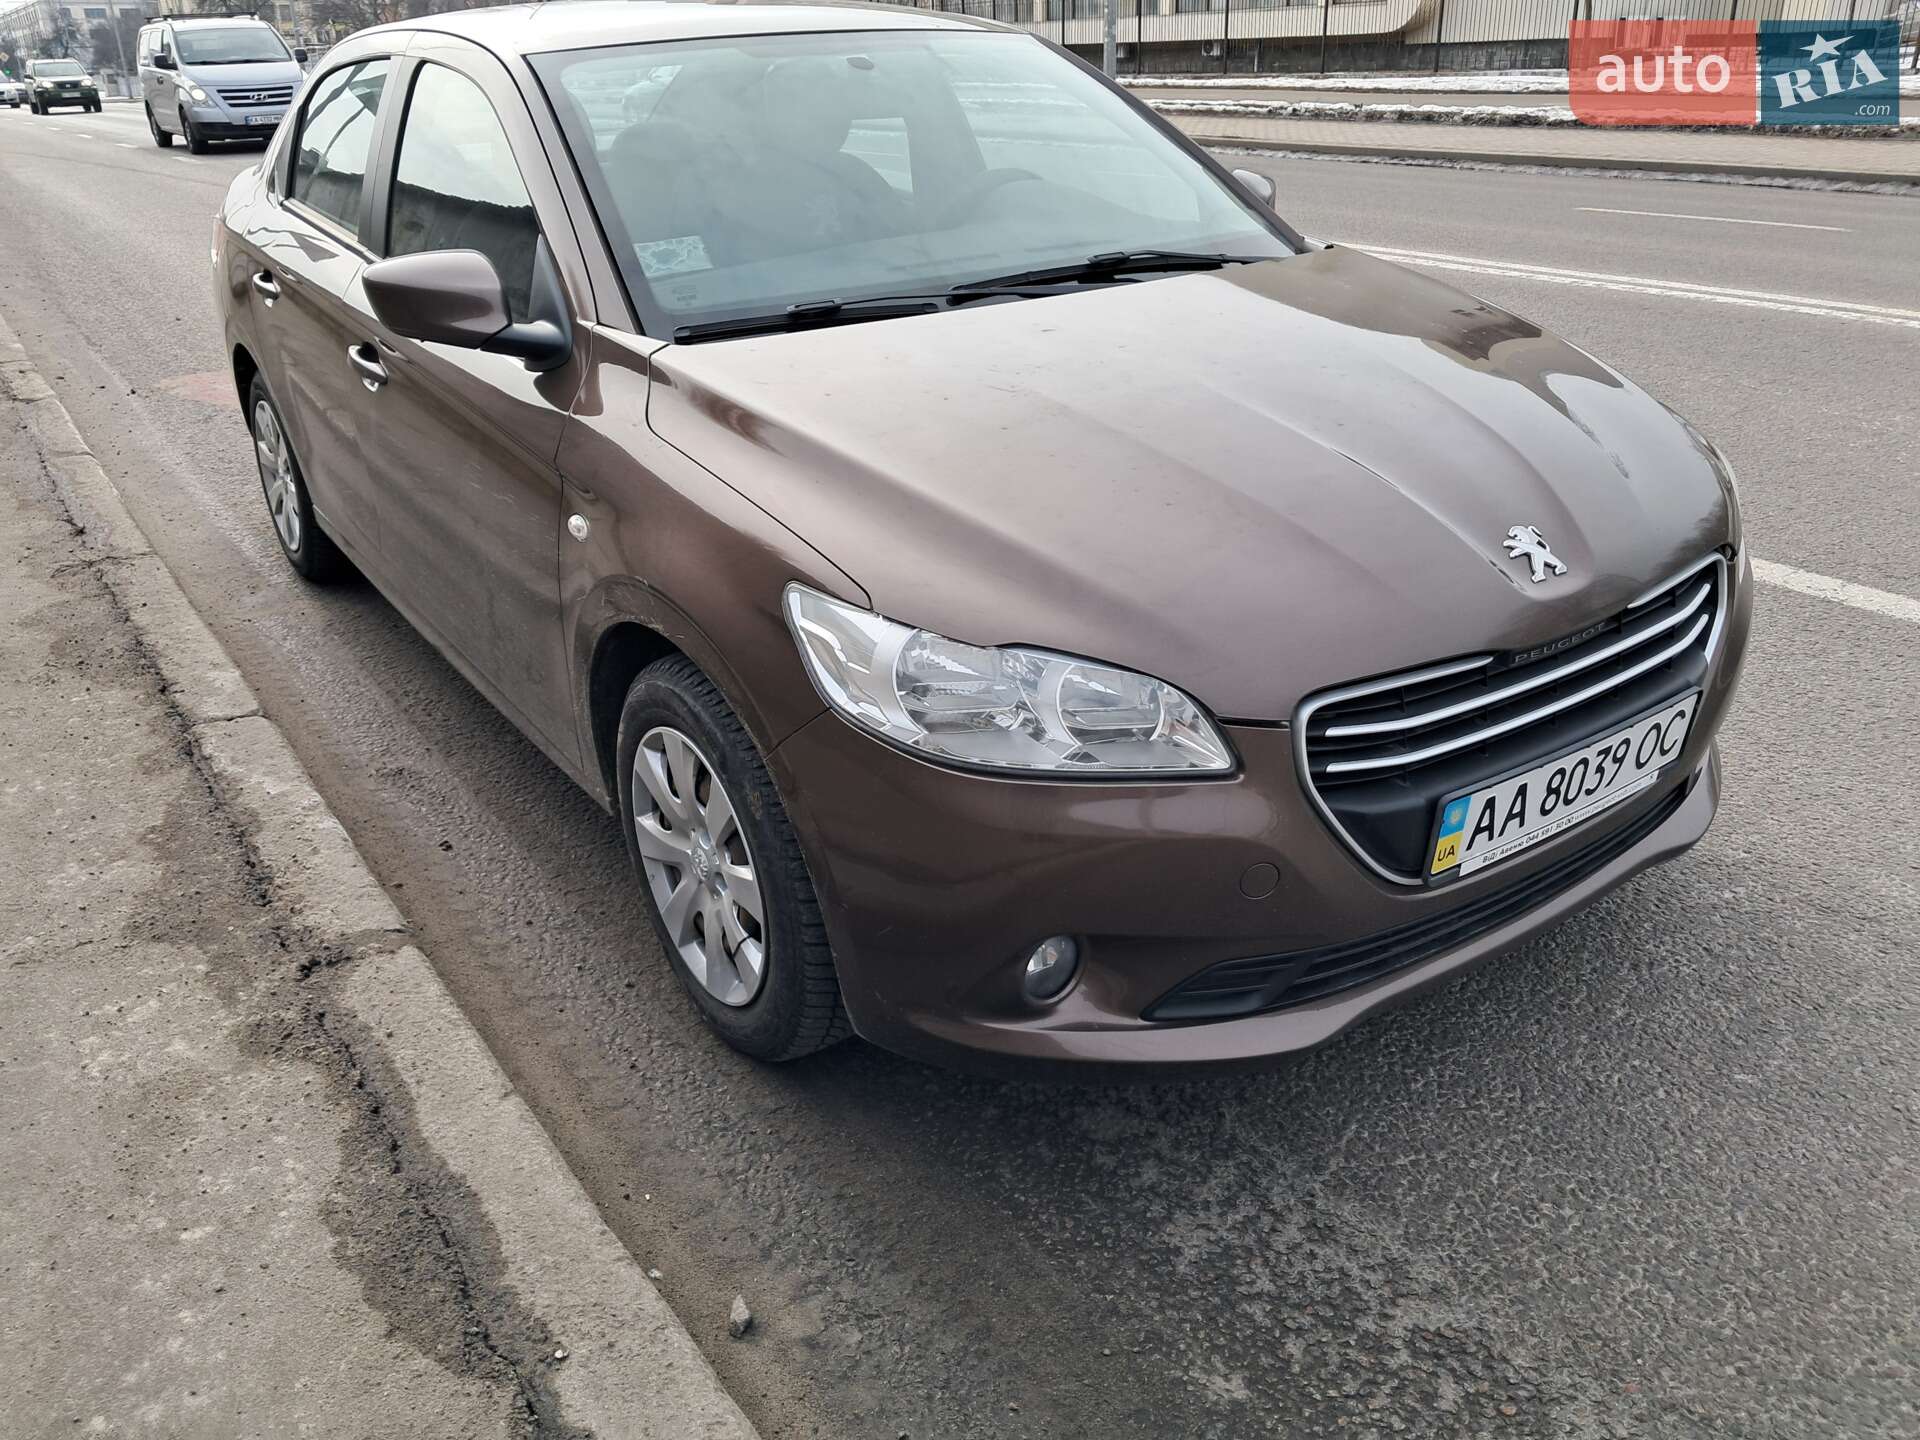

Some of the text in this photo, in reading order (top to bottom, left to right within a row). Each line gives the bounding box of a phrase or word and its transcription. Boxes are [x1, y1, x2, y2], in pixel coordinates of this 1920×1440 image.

[1515, 622, 1606, 663] PEUGEOT
[1465, 783, 1527, 851] AA
[1540, 737, 1631, 817] 8039
[1635, 709, 1686, 770] OC
[1437, 845, 1455, 862] UA
